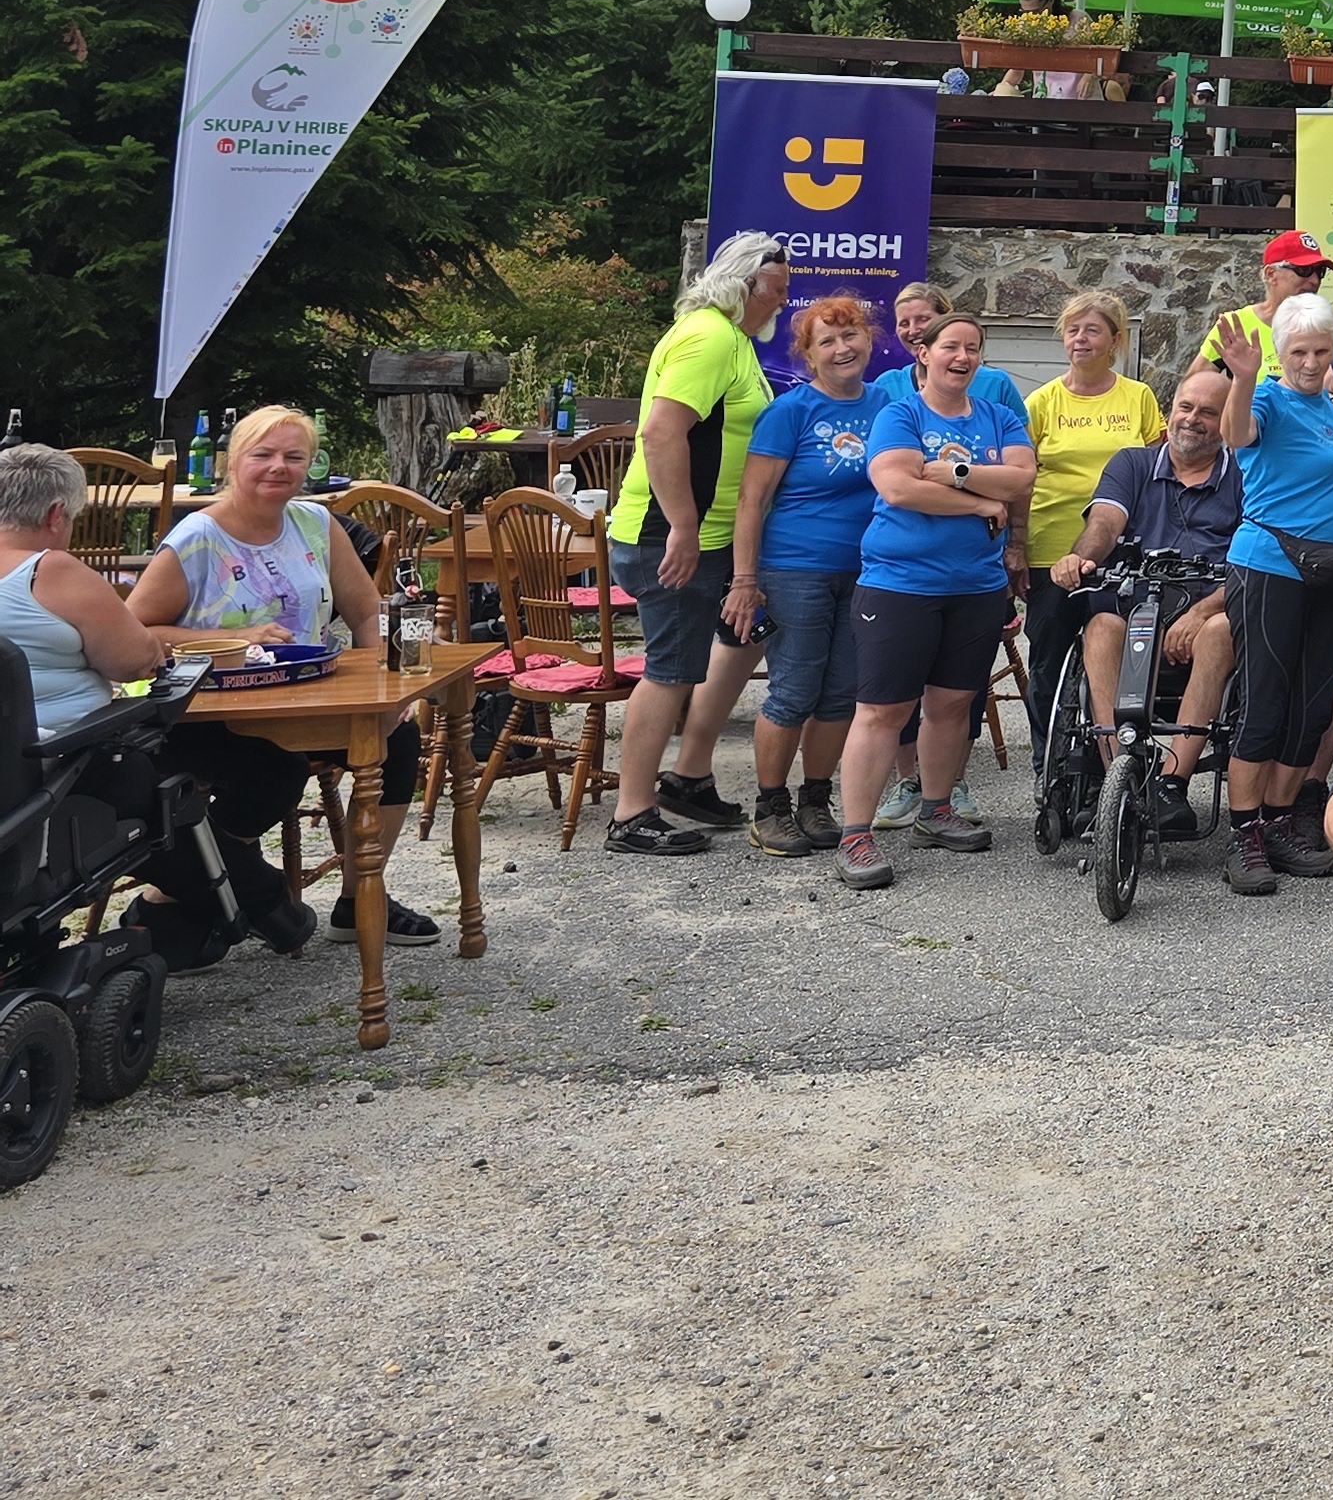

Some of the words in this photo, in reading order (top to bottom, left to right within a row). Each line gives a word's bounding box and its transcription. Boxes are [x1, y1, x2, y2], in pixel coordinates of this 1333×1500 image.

[203, 118, 274, 133] SKUPAJ
[278, 120, 291, 133] V
[294, 121, 350, 135] HRIBE
[815, 267, 863, 276] Payments.
[865, 268, 900, 278] Mining.
[1104, 410, 1130, 432] jami
[232, 565, 247, 581] B
[265, 561, 278, 576] E
[277, 594, 289, 611] T
[321, 587, 329, 603] L
[222, 670, 290, 688] FRUCTAL
